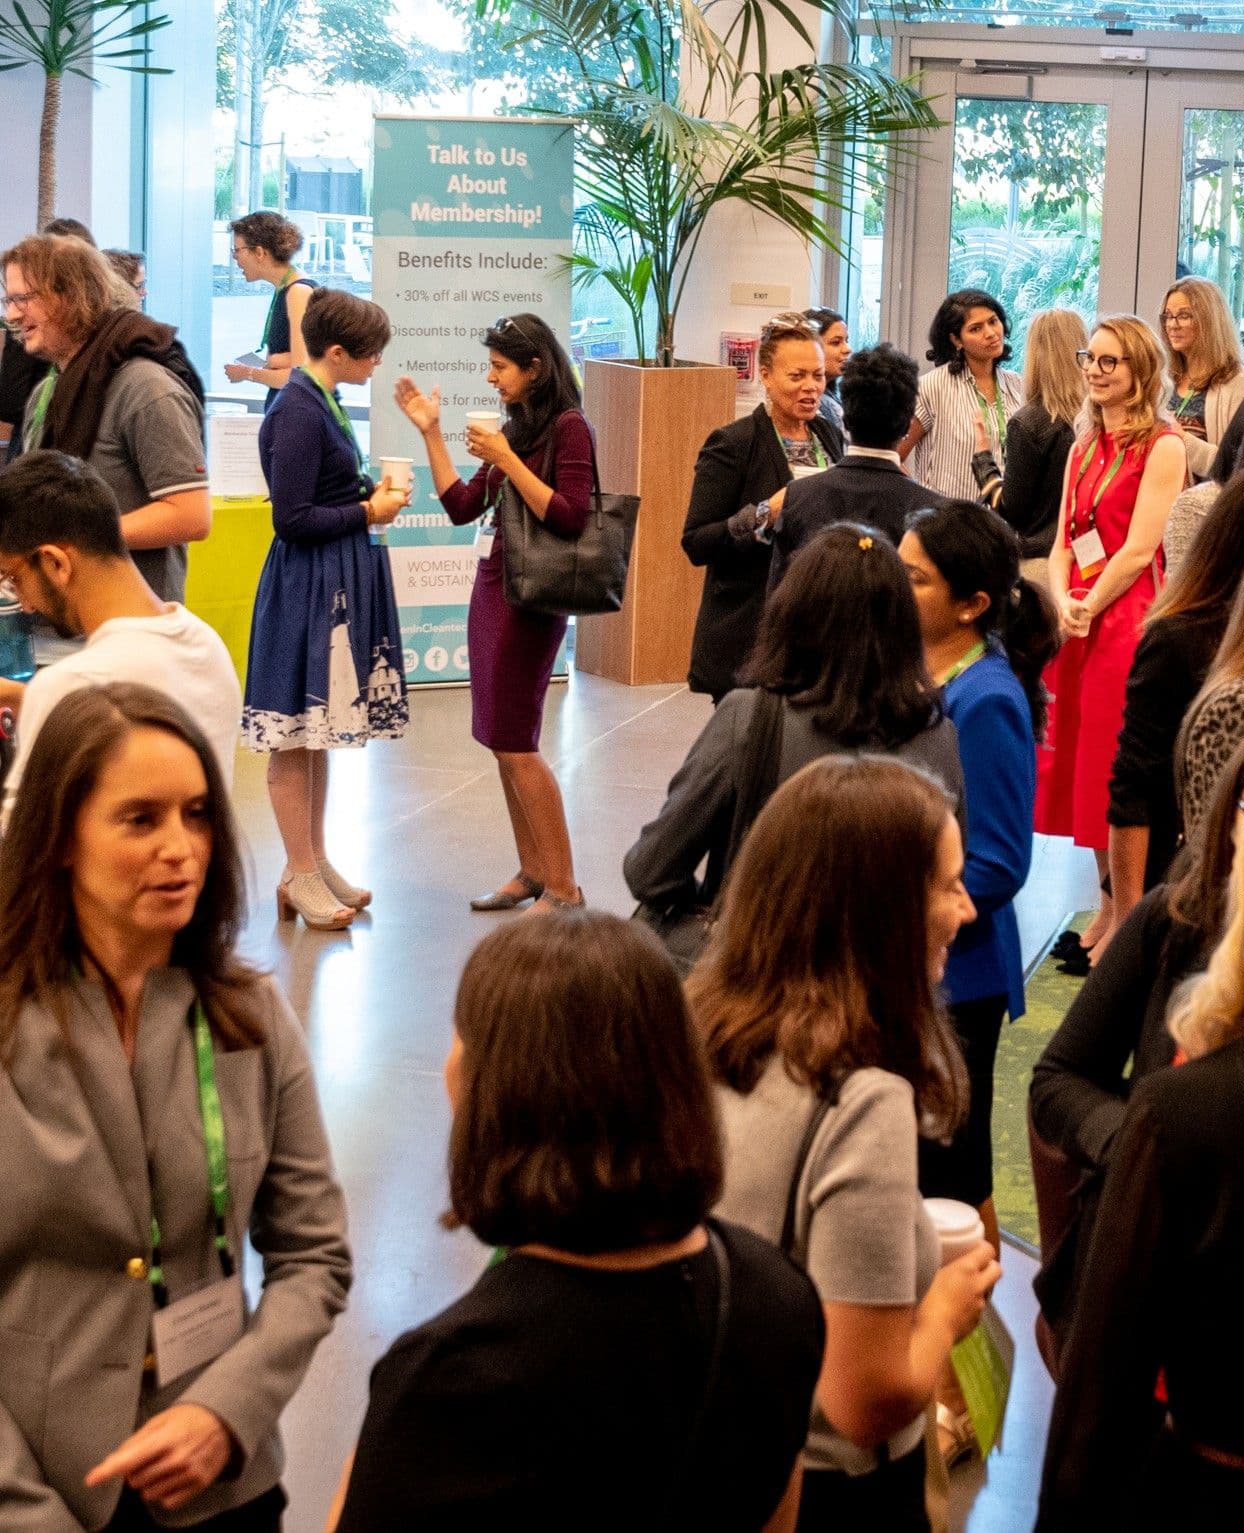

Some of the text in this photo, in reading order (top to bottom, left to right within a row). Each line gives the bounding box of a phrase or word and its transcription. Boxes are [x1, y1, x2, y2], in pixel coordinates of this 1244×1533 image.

[427, 144, 528, 167] Talk to Us
[447, 174, 507, 195] About
[411, 202, 542, 228] Membership!
[398, 251, 548, 270] Benefits Include:
[404, 290, 543, 303] 30% off all WCS events
[454, 326, 466, 337] to
[407, 359, 477, 373] Mentorship
[453, 393, 469, 405] for
[473, 396, 497, 405] new
[442, 429, 466, 441] and
[408, 560, 460, 572] WOMEN
[408, 575, 474, 587] & SUSTAIN
[400, 623, 467, 634] eninCleantec
